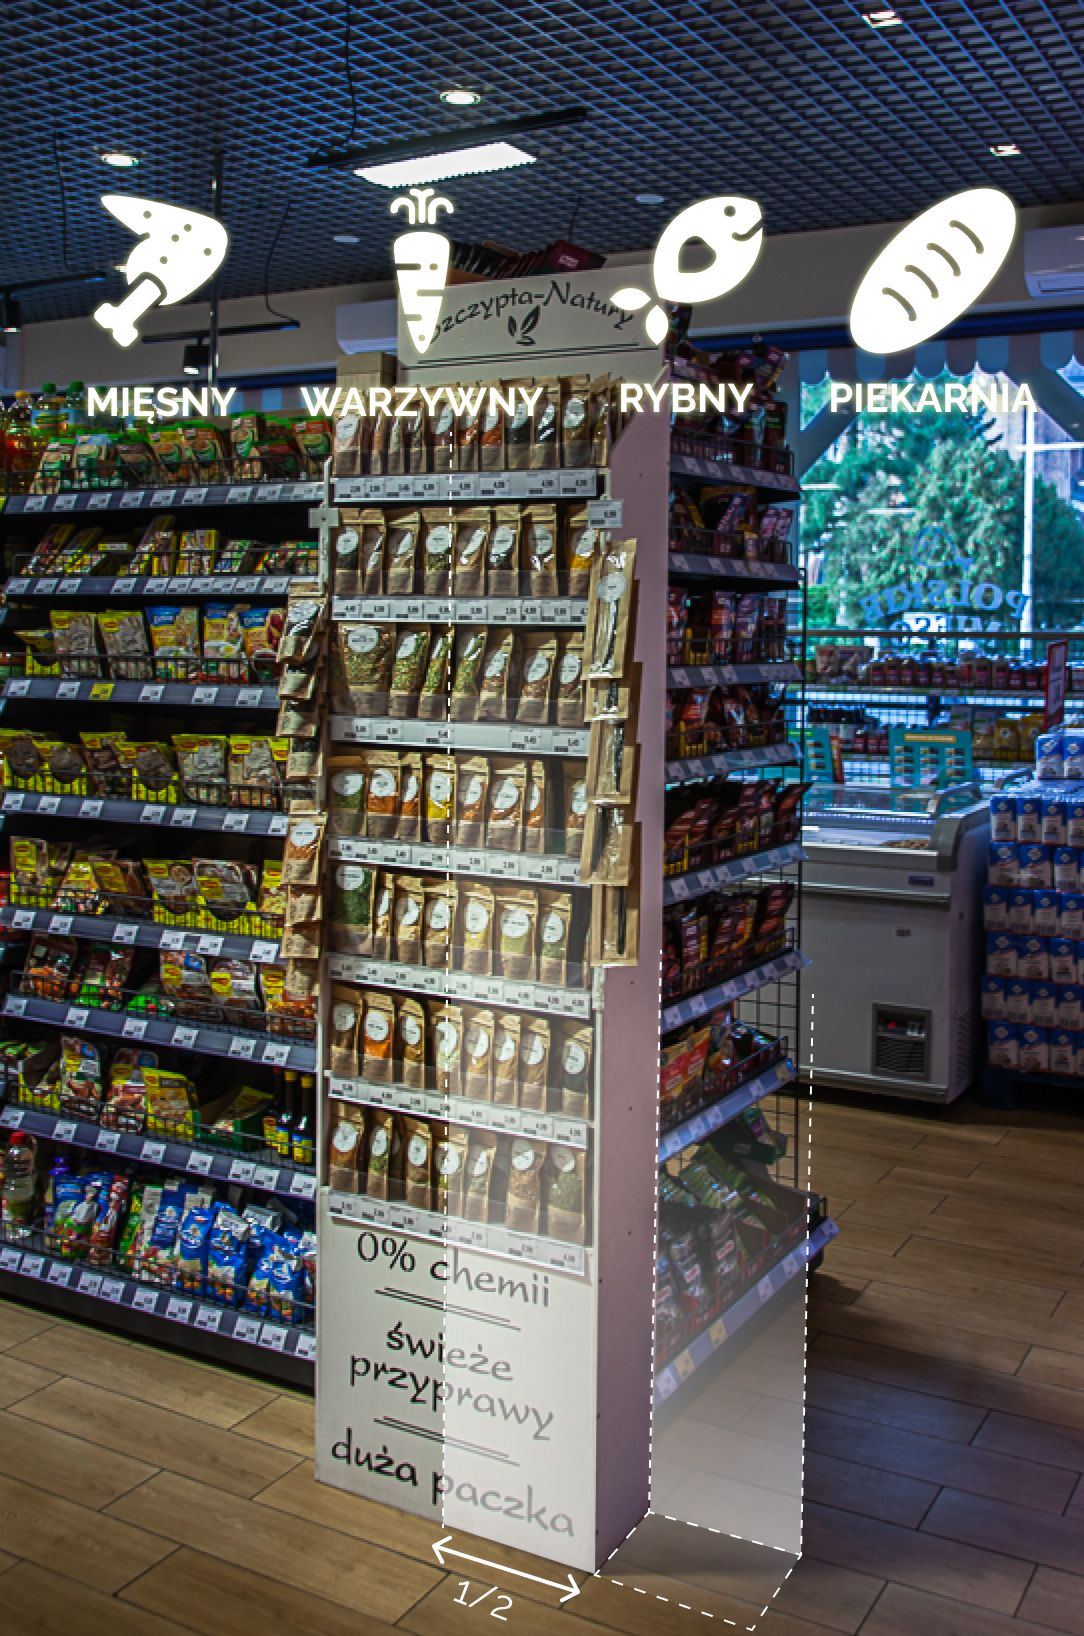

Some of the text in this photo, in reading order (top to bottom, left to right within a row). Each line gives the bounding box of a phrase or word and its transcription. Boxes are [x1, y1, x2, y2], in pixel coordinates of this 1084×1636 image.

[357, 1231, 550, 1307] 0% chemii
[385, 1321, 514, 1383] świeże
[350, 1353, 554, 1441] przyprawy
[331, 1426, 575, 1538] duża paczka
